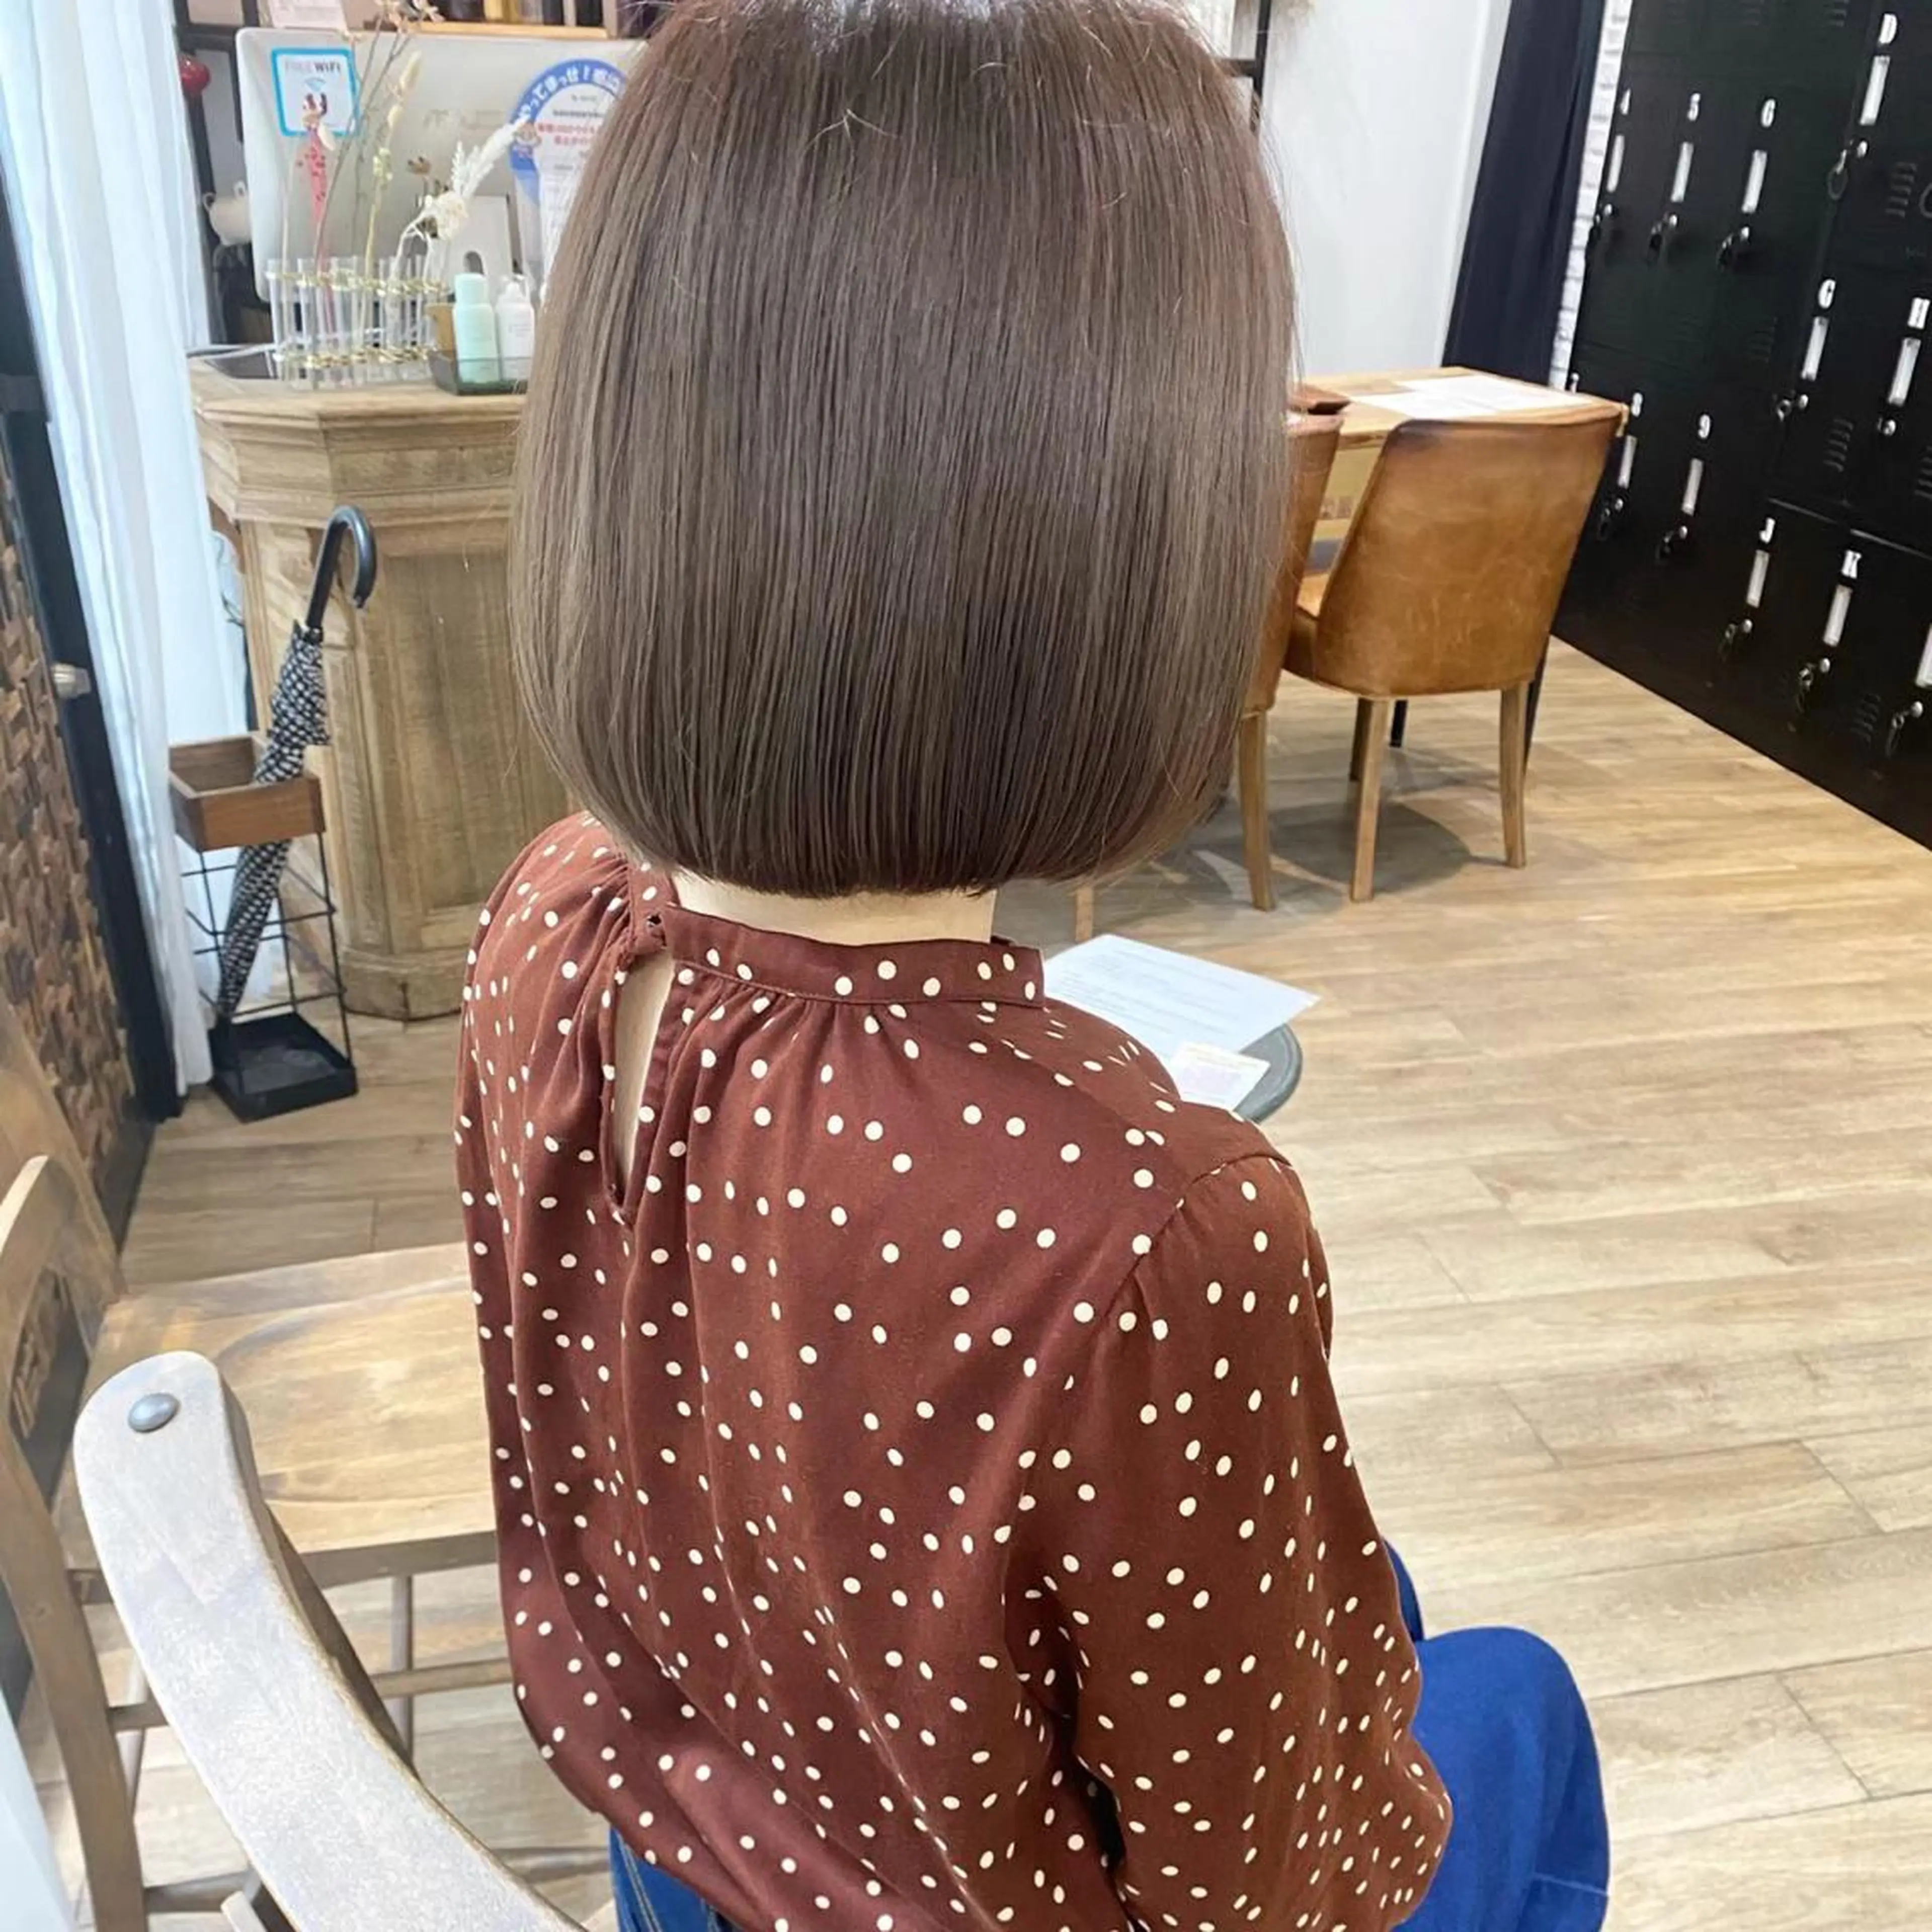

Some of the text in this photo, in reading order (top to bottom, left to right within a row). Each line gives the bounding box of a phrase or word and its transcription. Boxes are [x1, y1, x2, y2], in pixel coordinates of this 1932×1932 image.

[1687, 93, 1701, 121] 5
[1761, 99, 1776, 127] 6
[1698, 414, 1711, 438] 9
[1759, 517, 1776, 543] J
[1841, 549, 1862, 579] K
